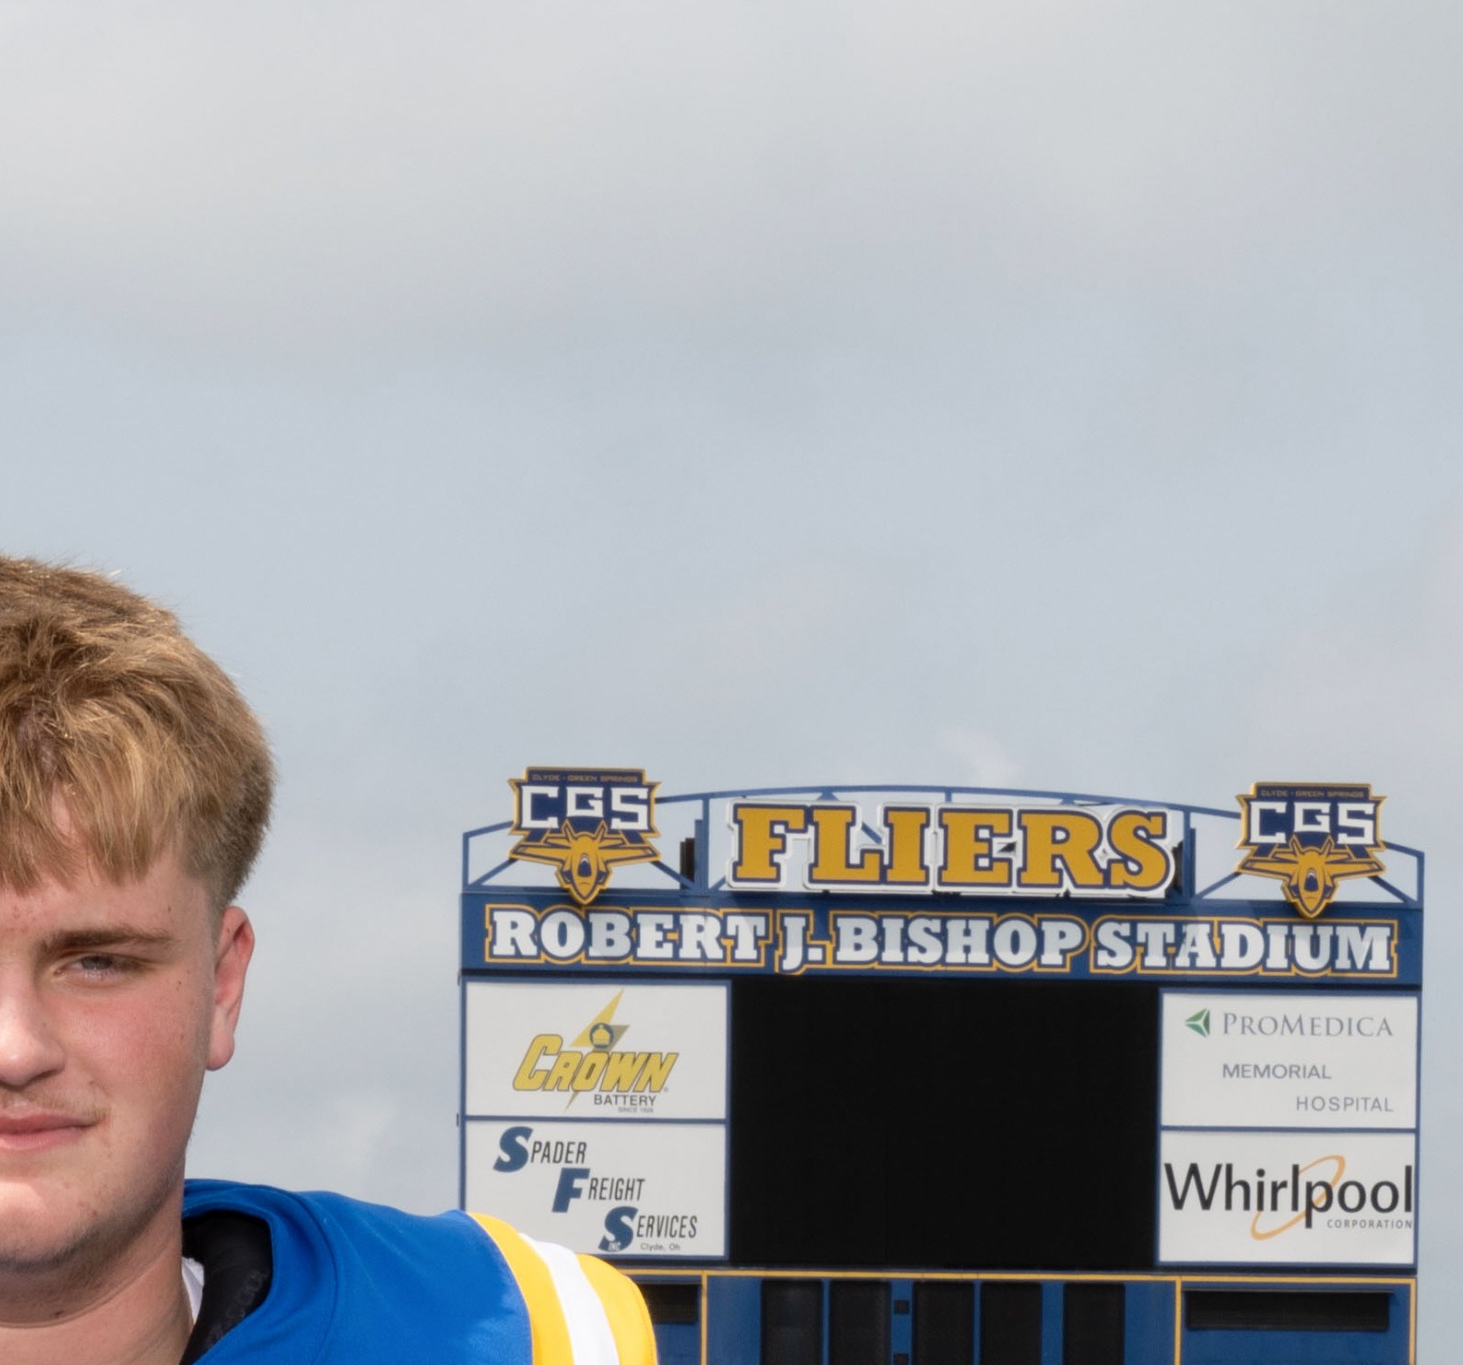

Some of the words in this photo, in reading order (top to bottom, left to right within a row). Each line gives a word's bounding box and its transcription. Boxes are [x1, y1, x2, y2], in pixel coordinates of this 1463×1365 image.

[520, 784, 650, 831] CGS
[1247, 800, 1378, 847] CGS
[730, 800, 1173, 893] FLIERS
[489, 907, 770, 963] ROBERT
[780, 914, 826, 973] J.
[835, 914, 1086, 970] BISHOP
[1094, 919, 1393, 974] STADIUM
[512, 1033, 680, 1093] CROWN
[1221, 1063, 1333, 1080] MEMORIAL
[593, 1093, 657, 1107] BATTERY
[1295, 1095, 1395, 1113] HOSPITAL
[492, 1125, 588, 1174] SPADER
[551, 1167, 646, 1214] FREIGHT
[1163, 1162, 1413, 1230] Whirlpool
[597, 1205, 699, 1253] SERVICES
[1326, 1218, 1413, 1230] CORPORATION
